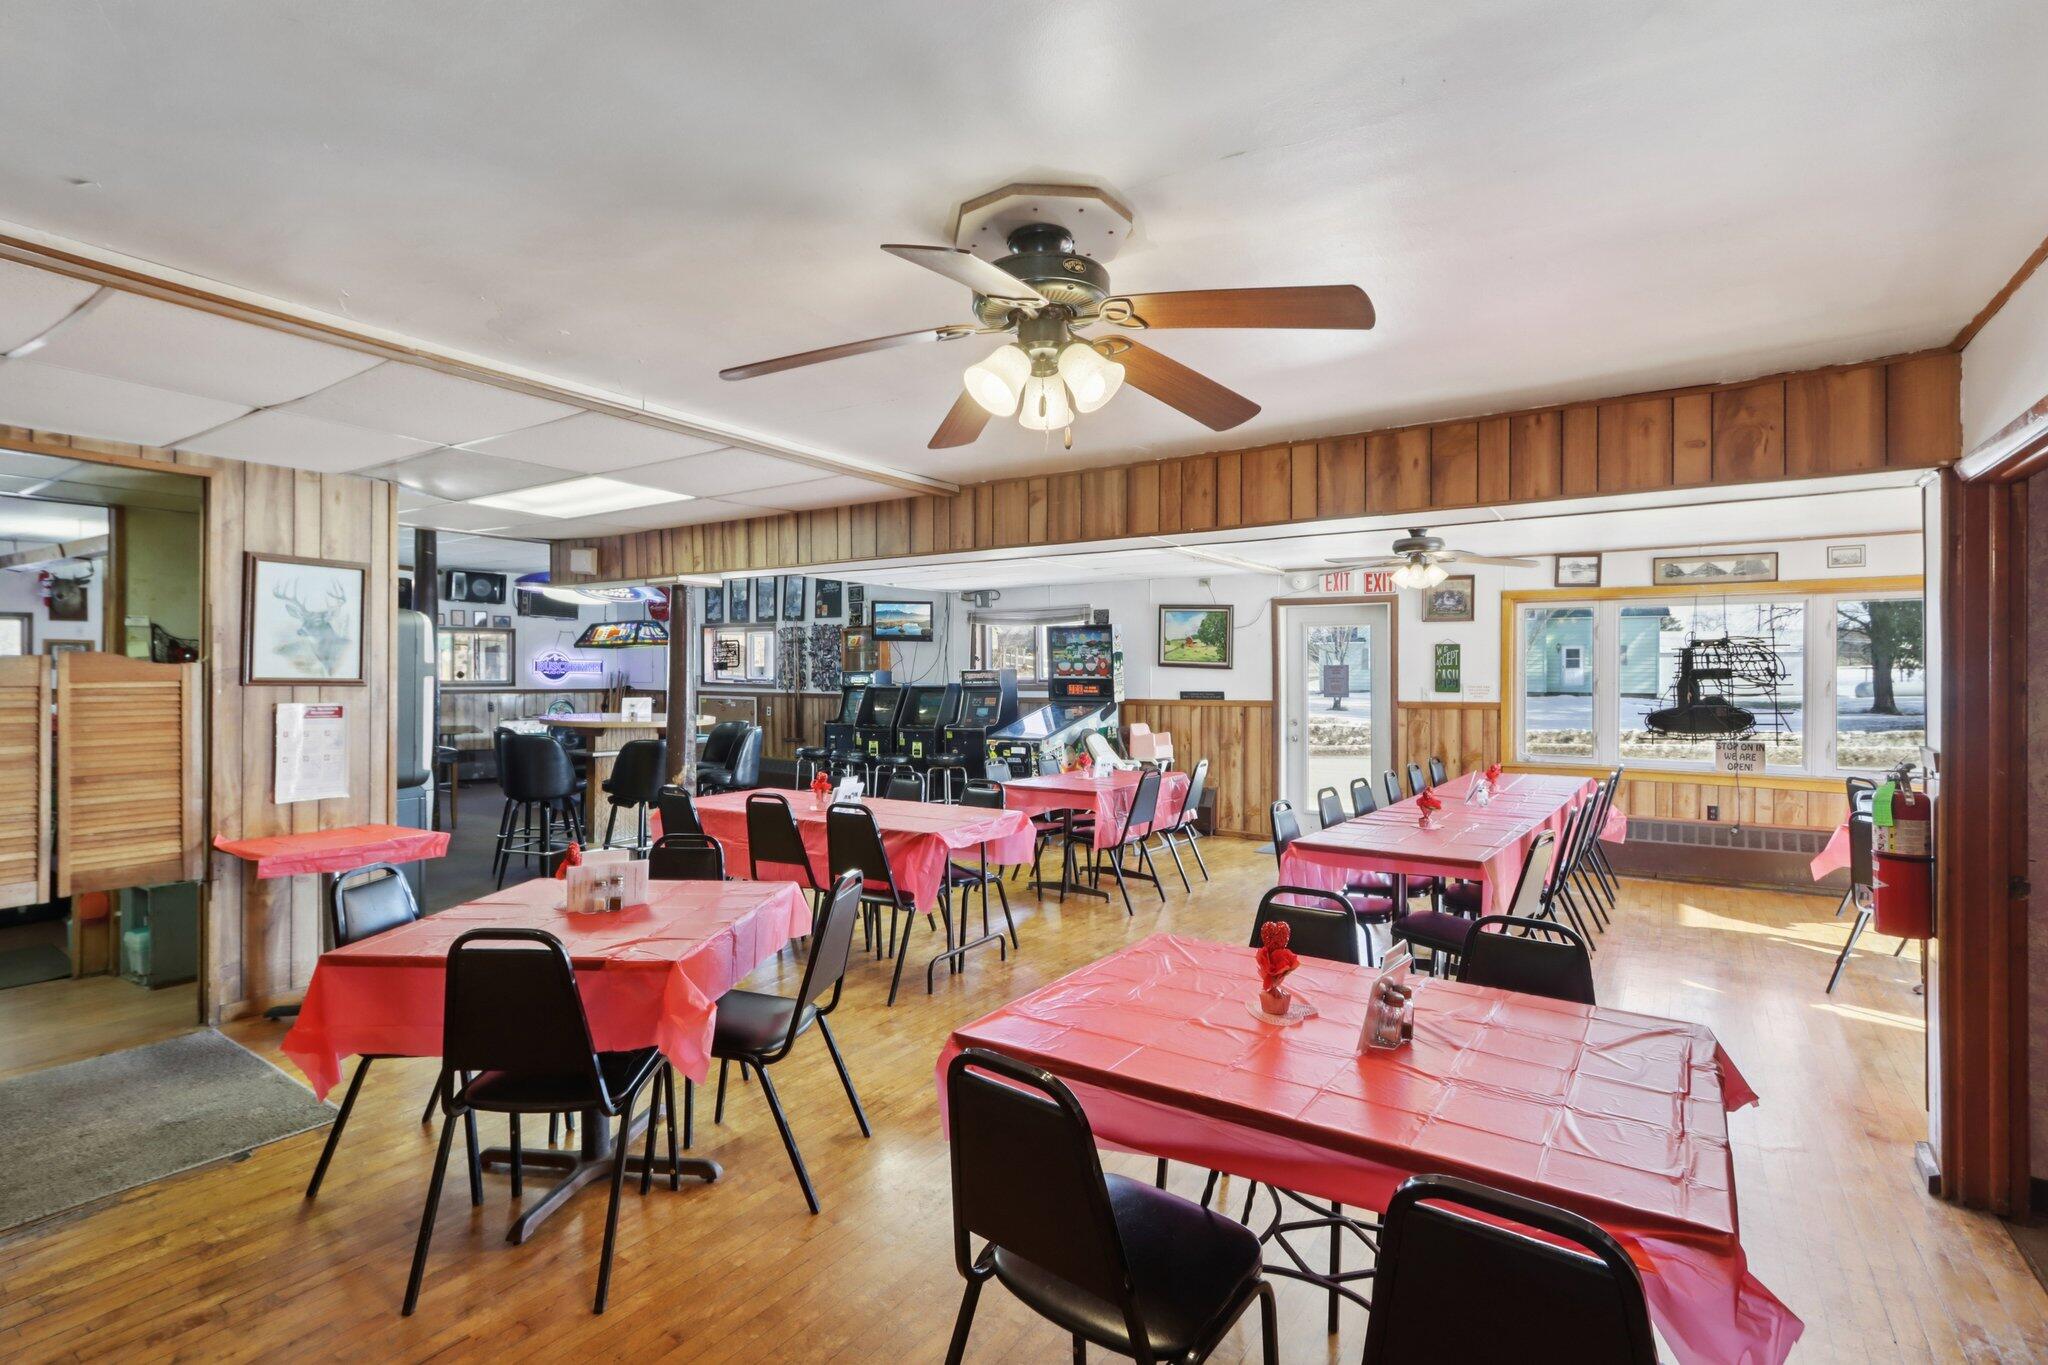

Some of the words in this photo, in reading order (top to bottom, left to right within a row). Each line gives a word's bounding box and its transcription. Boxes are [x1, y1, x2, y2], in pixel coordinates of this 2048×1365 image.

[1325, 572, 1350, 592] EXIT
[1365, 573, 1393, 592] EXIT
[1436, 645, 1449, 655] WE
[1716, 742, 1738, 750] STOP
[1740, 743, 1754, 751] ON
[1727, 763, 1753, 771] OPEN!
